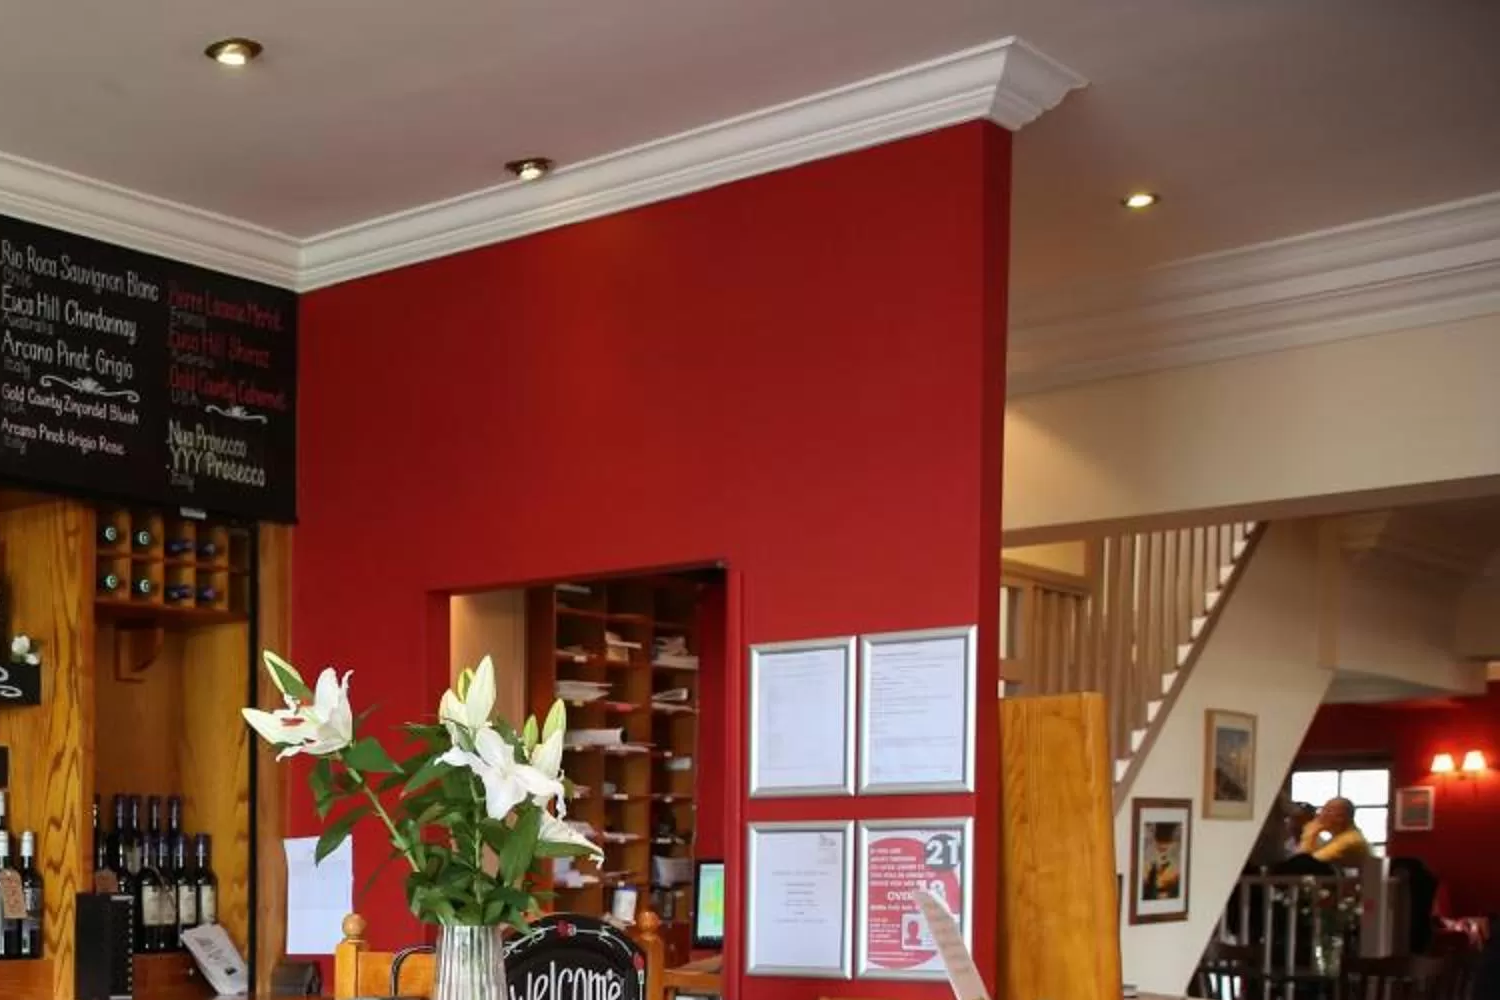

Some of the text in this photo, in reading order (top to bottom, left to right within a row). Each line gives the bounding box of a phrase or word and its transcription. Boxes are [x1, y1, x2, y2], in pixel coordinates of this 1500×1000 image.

[0, 239, 160, 303] Rio Roca Sauvignon Blanc
[37, 291, 61, 322] Hill
[64, 298, 138, 347] Chardonnay
[1, 329, 53, 365] Arcano
[56, 339, 93, 372] Pinot
[95, 347, 134, 384] Grigio
[1, 382, 26, 403] Gold
[27, 387, 64, 417] County
[108, 403, 140, 425] Blush
[39, 423, 66, 445] Pinot
[67, 428, 98, 456] Grigio
[195, 422, 247, 459] Prosecco
[206, 450, 266, 488] Prosecco
[924, 838, 960, 866] 21
